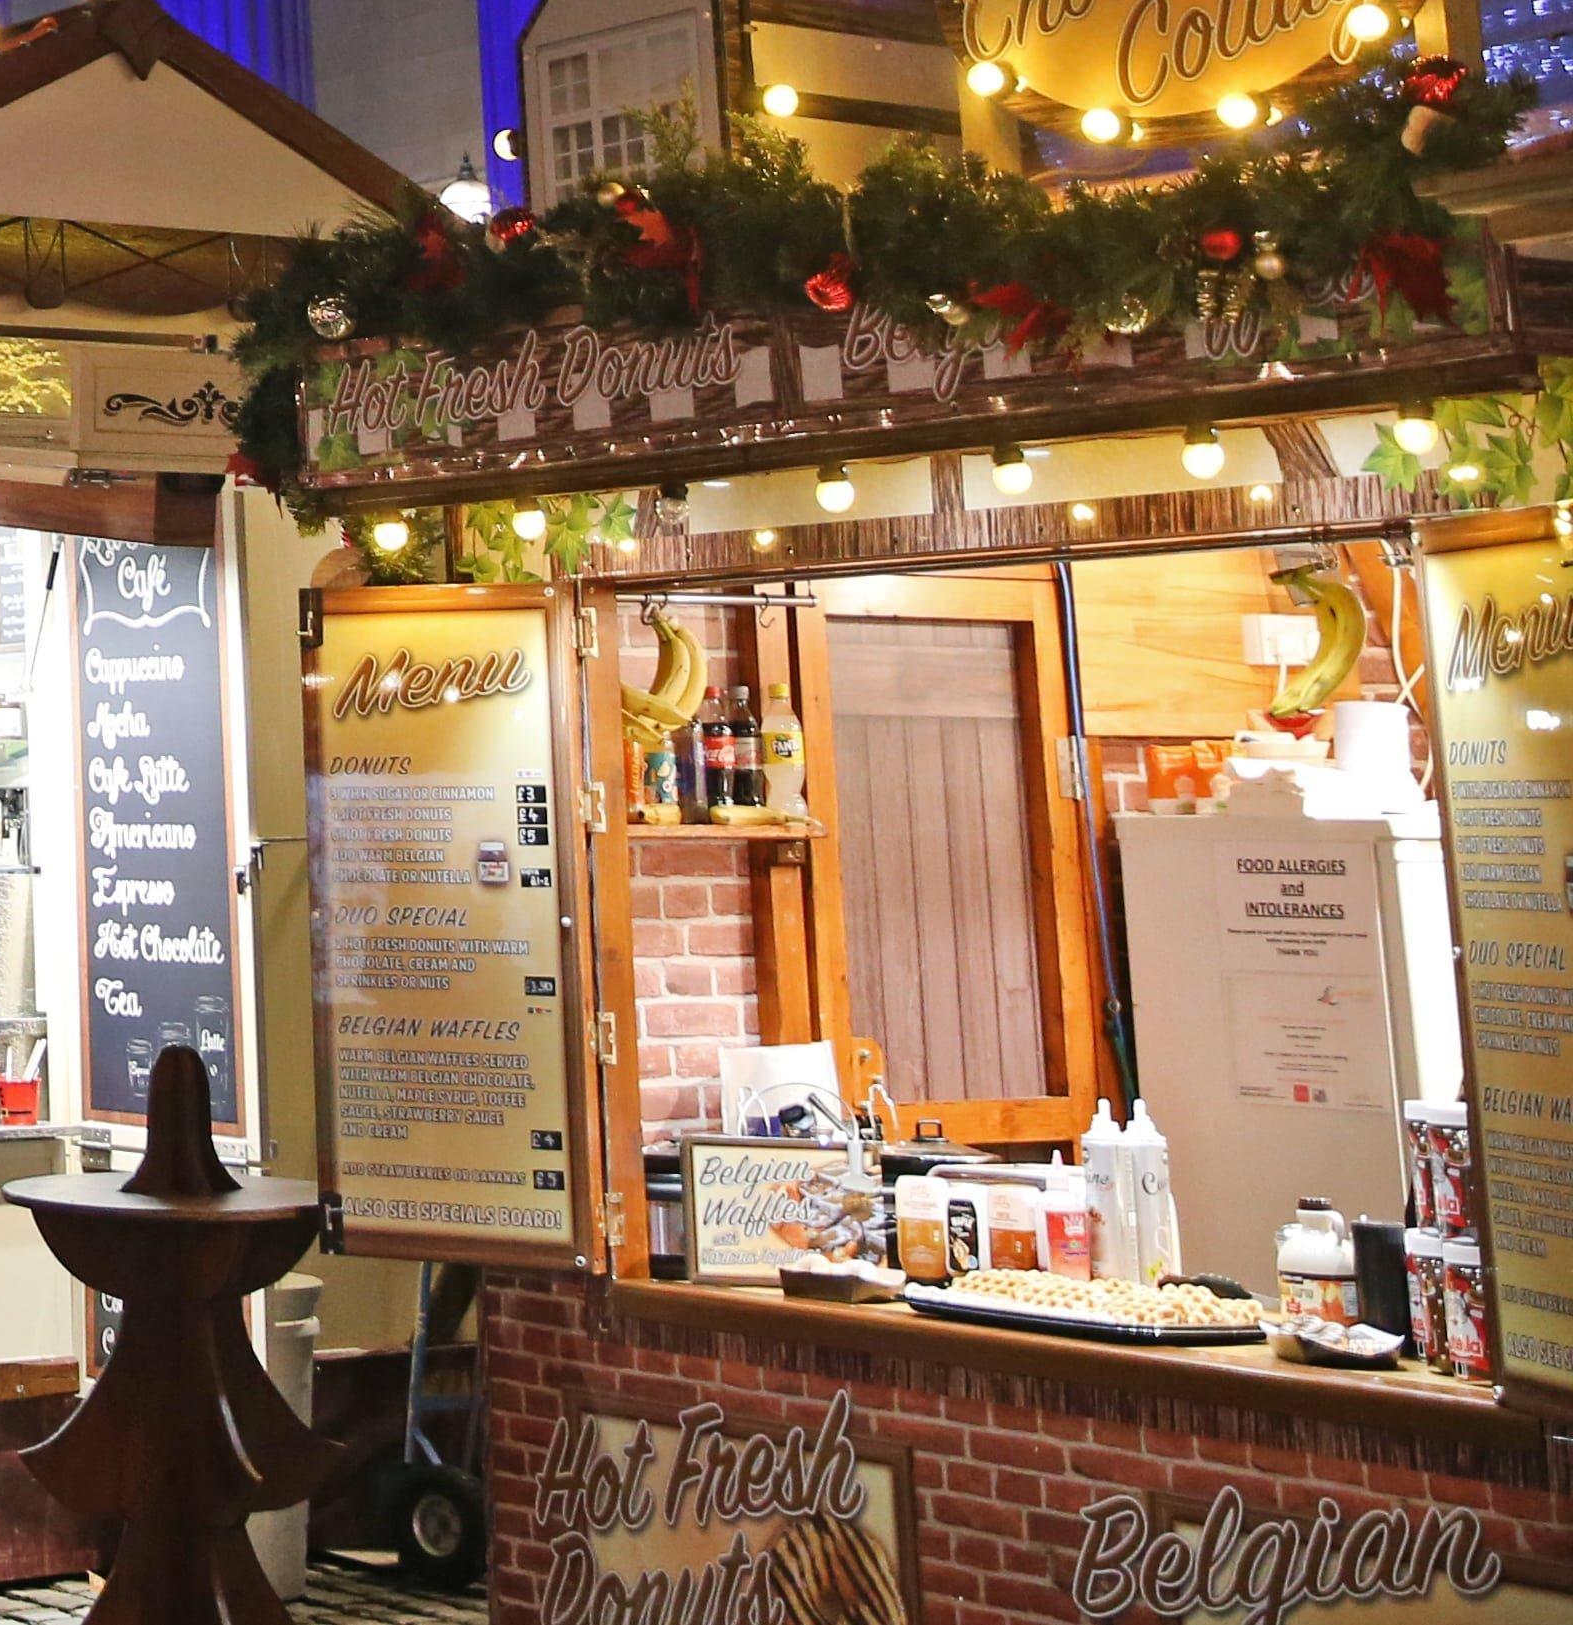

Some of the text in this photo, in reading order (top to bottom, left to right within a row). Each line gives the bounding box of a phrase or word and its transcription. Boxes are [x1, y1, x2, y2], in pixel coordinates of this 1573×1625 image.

[329, 354, 407, 436] Hot
[416, 329, 546, 426] Fresh
[553, 311, 741, 404] Donuts
[117, 553, 171, 612] Café
[1446, 593, 1573, 691] Menu
[333, 647, 532, 719] Menu
[1449, 739, 1507, 766] DONUTS
[330, 756, 413, 776] DONUTS
[372, 786, 410, 800] SUGAR
[412, 787, 430, 800] OR
[431, 786, 495, 801] CINNAMON
[517, 786, 535, 802] £3
[368, 807, 402, 821] FRESH
[405, 807, 453, 821] DONUTS
[518, 808, 539, 823] £4
[89, 806, 197, 859] Americano
[405, 828, 453, 842] DONUTS
[519, 828, 536, 844] £5
[358, 848, 394, 862] WARM
[396, 848, 445, 863] BELGIAN
[1237, 857, 1347, 875] FOOD ALLERGIES
[401, 869, 418, 883] OR
[420, 869, 472, 884] NUTELLA
[1280, 881, 1304, 896] and
[335, 906, 469, 927] DUO SPECIAL
[1245, 901, 1344, 919] INTOLERANCES
[94, 919, 225, 965] Hot Chocolate
[345, 938, 367, 950] HOT
[371, 939, 405, 951] FRESH
[409, 939, 455, 953] DONUTS
[458, 940, 490, 953] WITH
[492, 940, 529, 954] WARM
[409, 957, 449, 971] CREAM
[453, 958, 476, 972] AND
[1469, 939, 1566, 971] DUO SPECIAL
[336, 975, 450, 990] SPRINKLES OR NUTS
[95, 978, 143, 1017] Tea
[338, 1016, 521, 1042] BELGIAN WAFFLES
[339, 1048, 529, 1069] WARM BELGIAN WAFFLES SERVED
[339, 1067, 369, 1081] WITH
[371, 1068, 407, 1082] WARM
[410, 1070, 459, 1085] BELGIAN
[396, 1087, 435, 1103] MAPLE
[483, 1091, 526, 1108] TOFFEE
[1482, 1087, 1573, 1124] BELGIAN WA
[384, 1106, 462, 1124] STRAWBERRY
[465, 1110, 504, 1125] SAUCE
[341, 1123, 409, 1139] AND CREAM
[367, 1164, 453, 1181] STRAWBERRIES
[473, 1169, 526, 1185] BANANAS
[699, 1155, 814, 1200] Belgian
[343, 1197, 562, 1229] ALSO SEE SPECIALS BOARD!
[702, 1195, 813, 1237] Waffles
[535, 1388, 868, 1531] Hot Fresh
[1072, 1485, 1501, 1625] Belgian
[539, 1530, 786, 1625] Donuts
